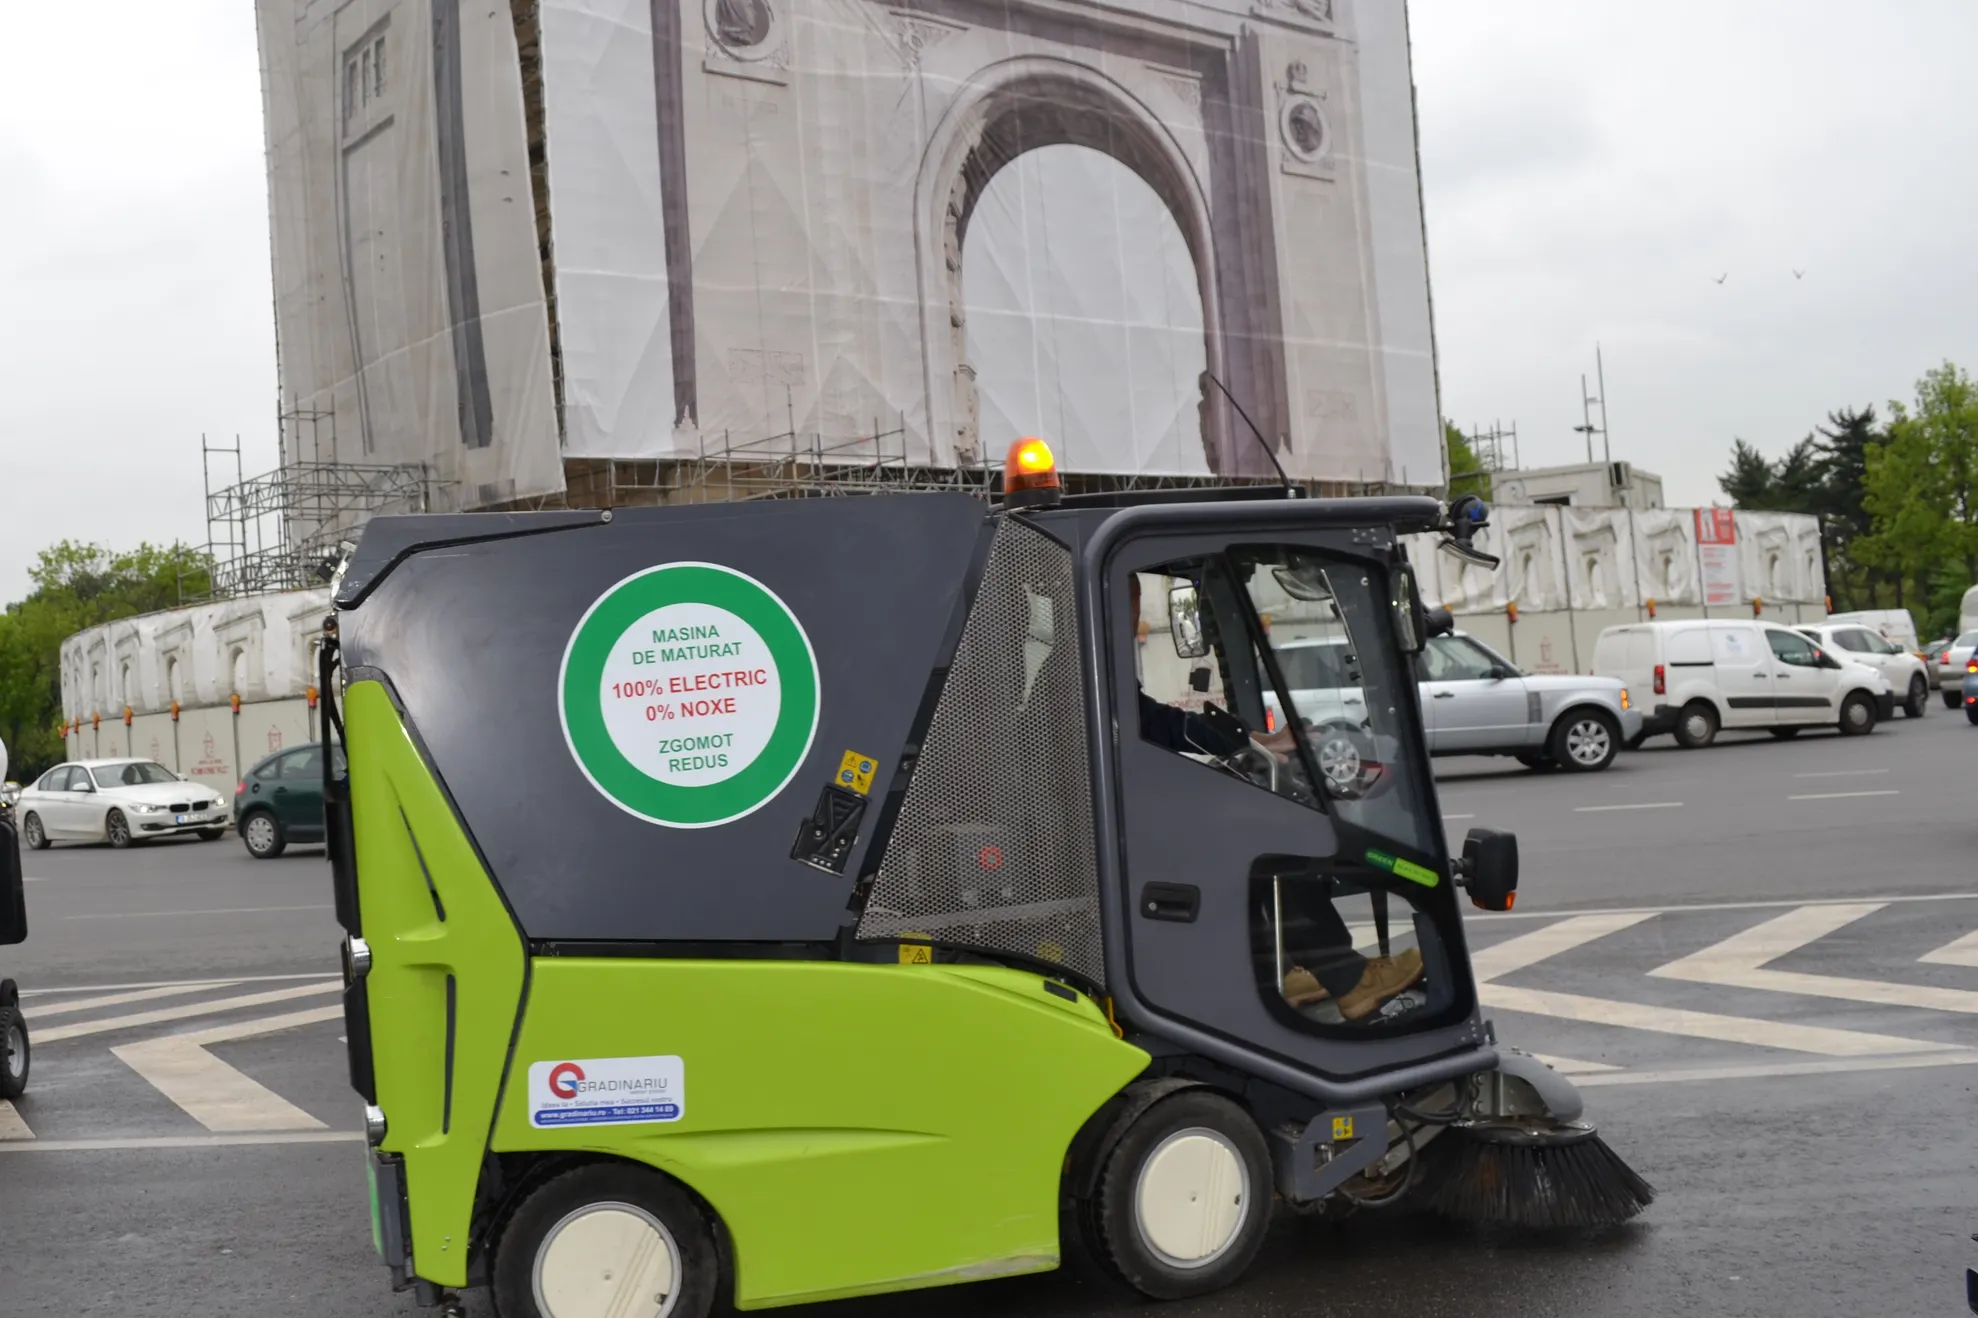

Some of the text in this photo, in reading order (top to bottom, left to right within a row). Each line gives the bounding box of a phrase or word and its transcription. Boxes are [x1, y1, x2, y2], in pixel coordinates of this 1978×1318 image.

[652, 625, 720, 644] MASINA
[632, 641, 742, 665] DE MATURAT
[612, 669, 768, 699] 100% ELECTRIC
[646, 697, 737, 721] 0% NOXE
[659, 733, 734, 754] ZGOMOT
[669, 753, 729, 773] REDUS
[577, 1078, 668, 1093] GRADINARIU
